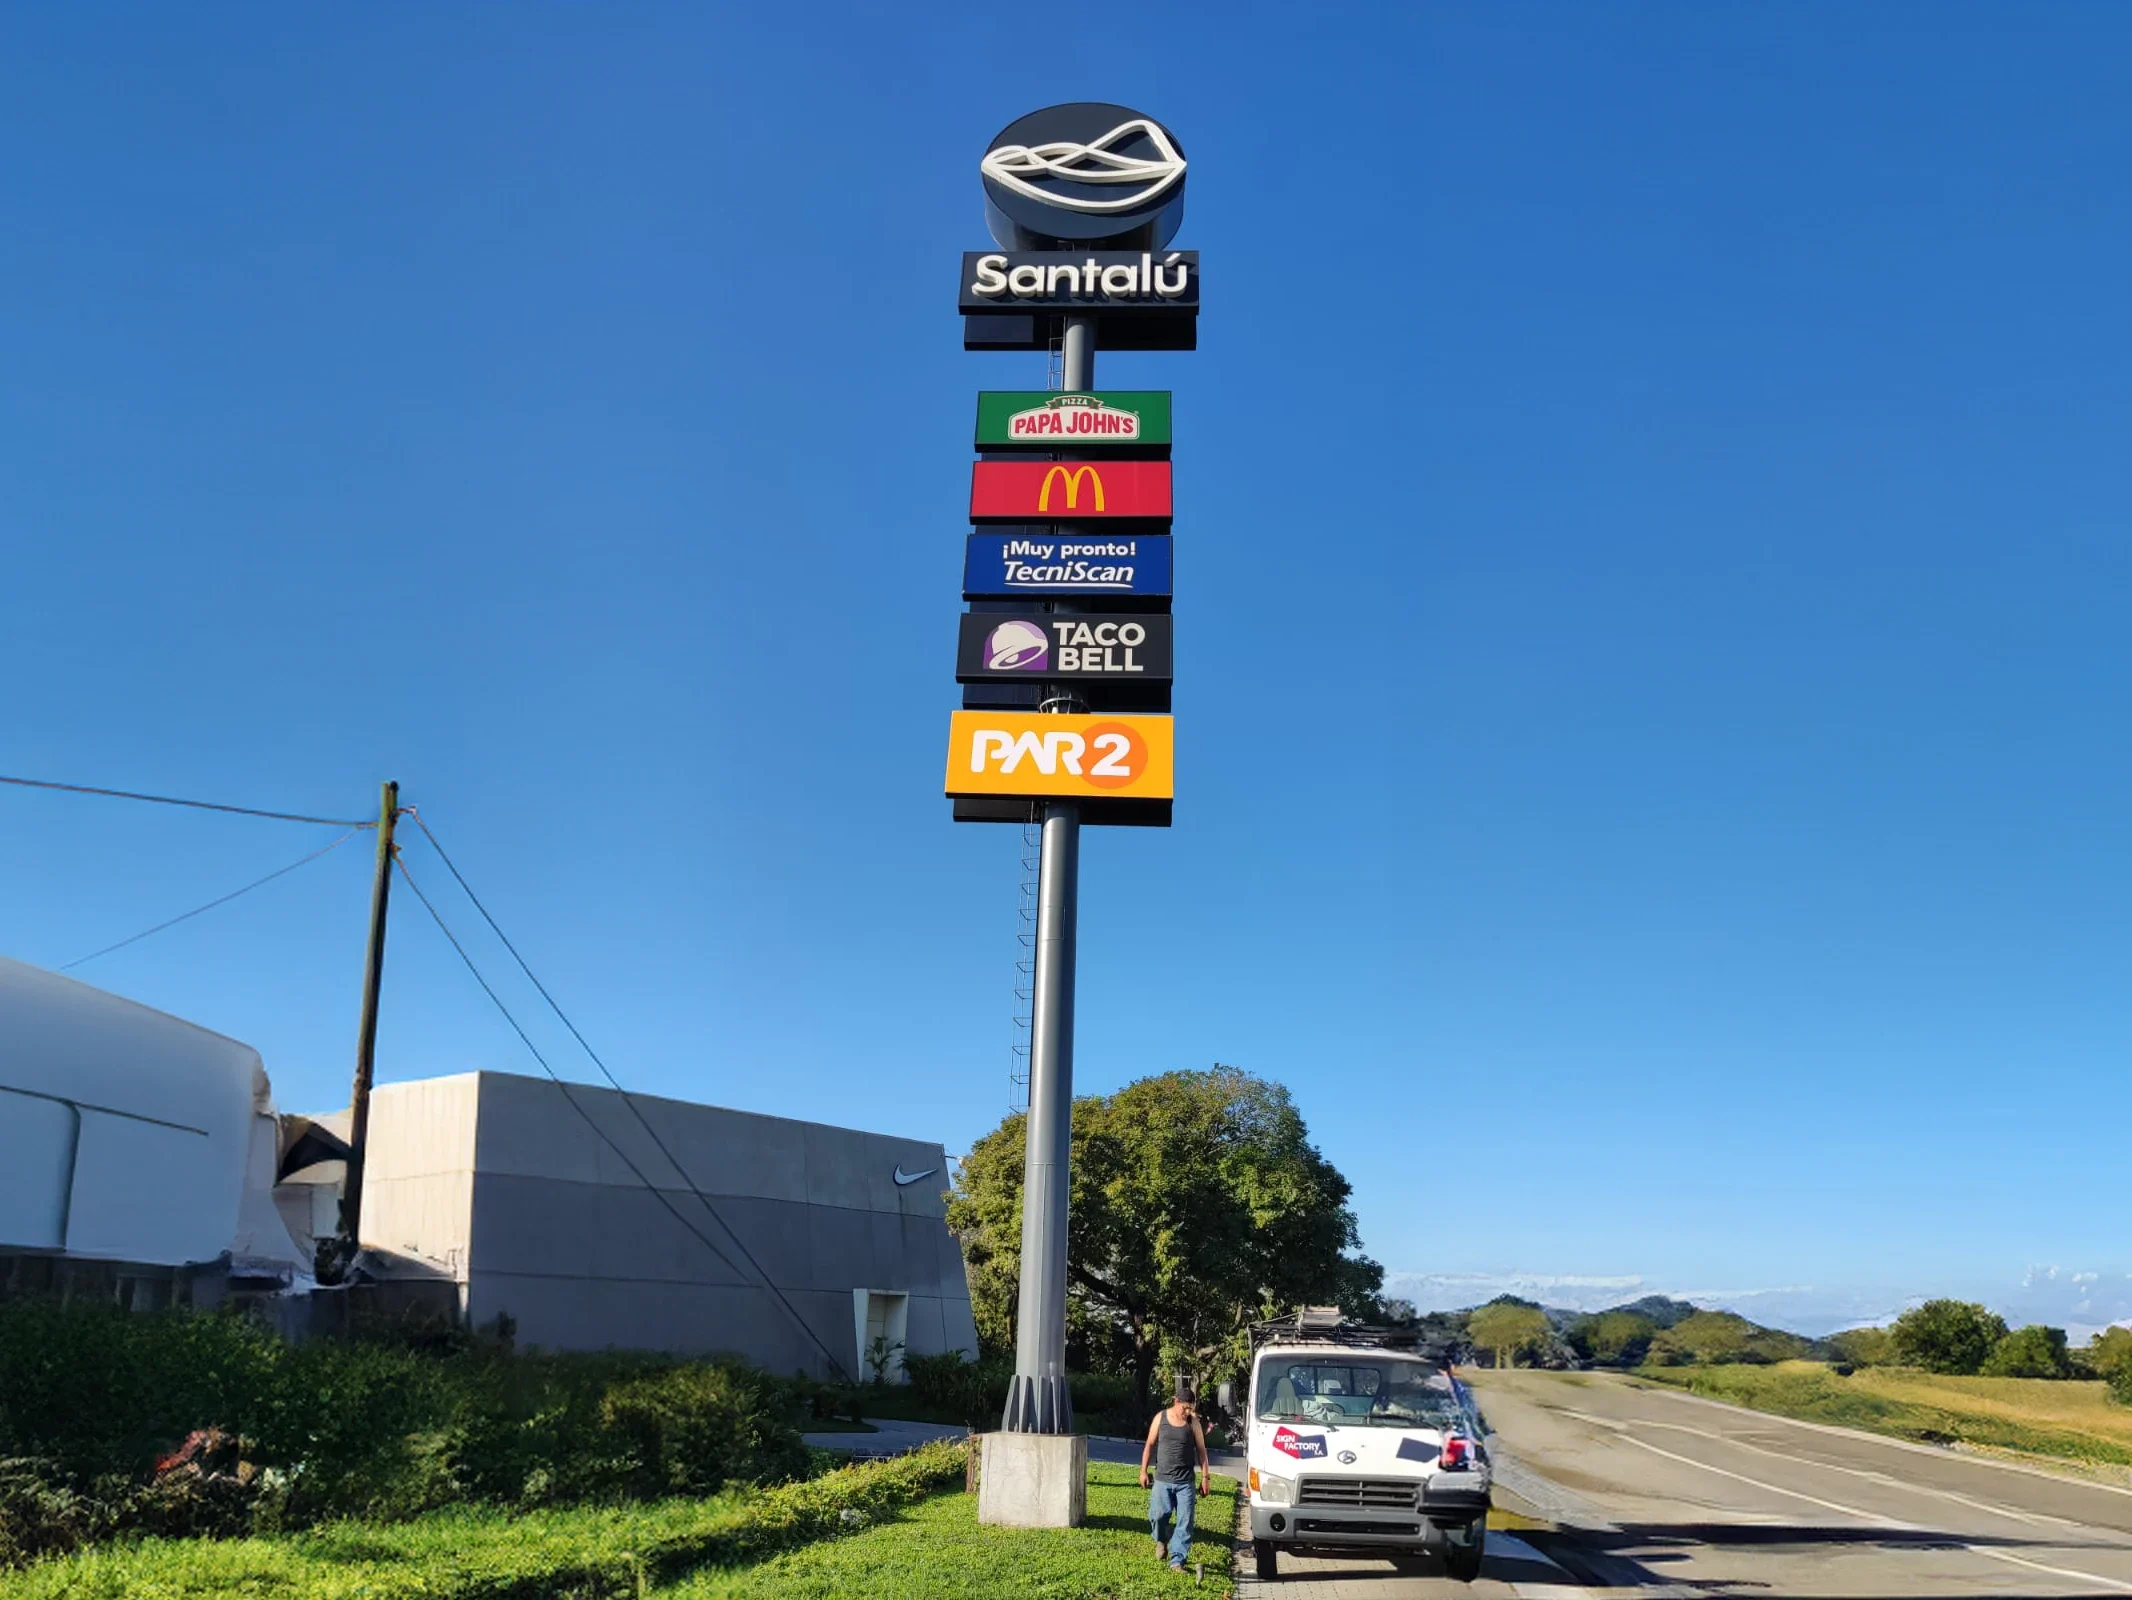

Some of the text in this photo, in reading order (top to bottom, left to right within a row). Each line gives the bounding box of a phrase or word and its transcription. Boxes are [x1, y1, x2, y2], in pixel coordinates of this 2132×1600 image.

[971, 252, 1188, 298] Santalú
[1061, 397, 1088, 406] PIZZA
[1014, 411, 1134, 434] PAPA JOHN'S
[1003, 541, 1136, 560] ¡Muy pronto!
[1004, 561, 1134, 582] TecniScan
[1053, 622, 1146, 646] TACO
[1058, 647, 1144, 672] BELL
[1090, 733, 1130, 776] 2
[1284, 1442, 1320, 1450] FACTORY
